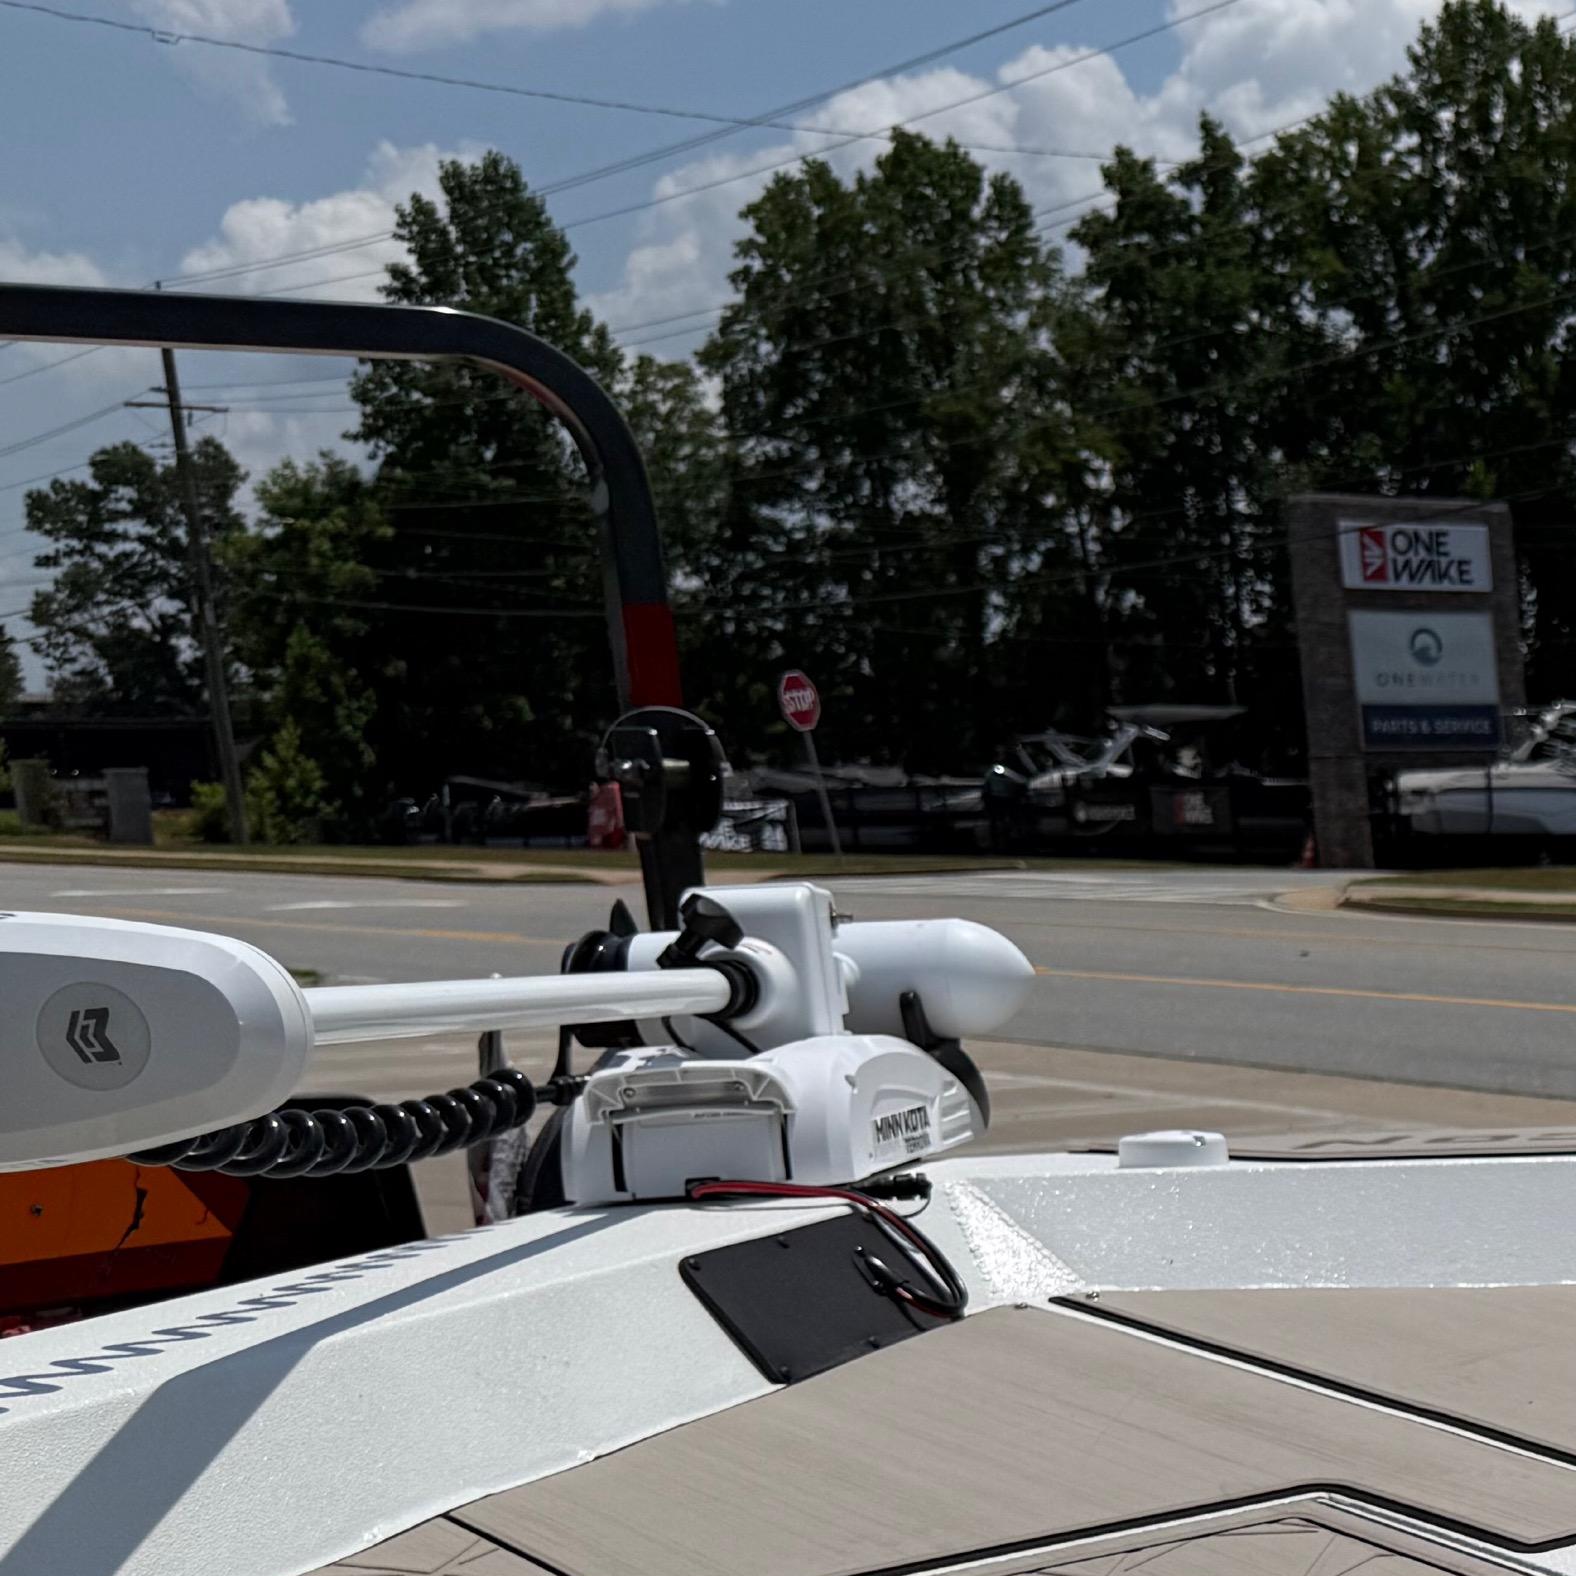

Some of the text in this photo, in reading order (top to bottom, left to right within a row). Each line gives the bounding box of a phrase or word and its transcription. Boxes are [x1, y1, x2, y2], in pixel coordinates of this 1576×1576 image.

[1391, 530, 1450, 557] ONE
[1391, 557, 1474, 585] WAKE
[782, 687, 815, 714] STOP
[1371, 718, 1418, 735] PARTS
[1432, 718, 1494, 735] SERVICE
[874, 1105, 931, 1144] MINN KOTA
